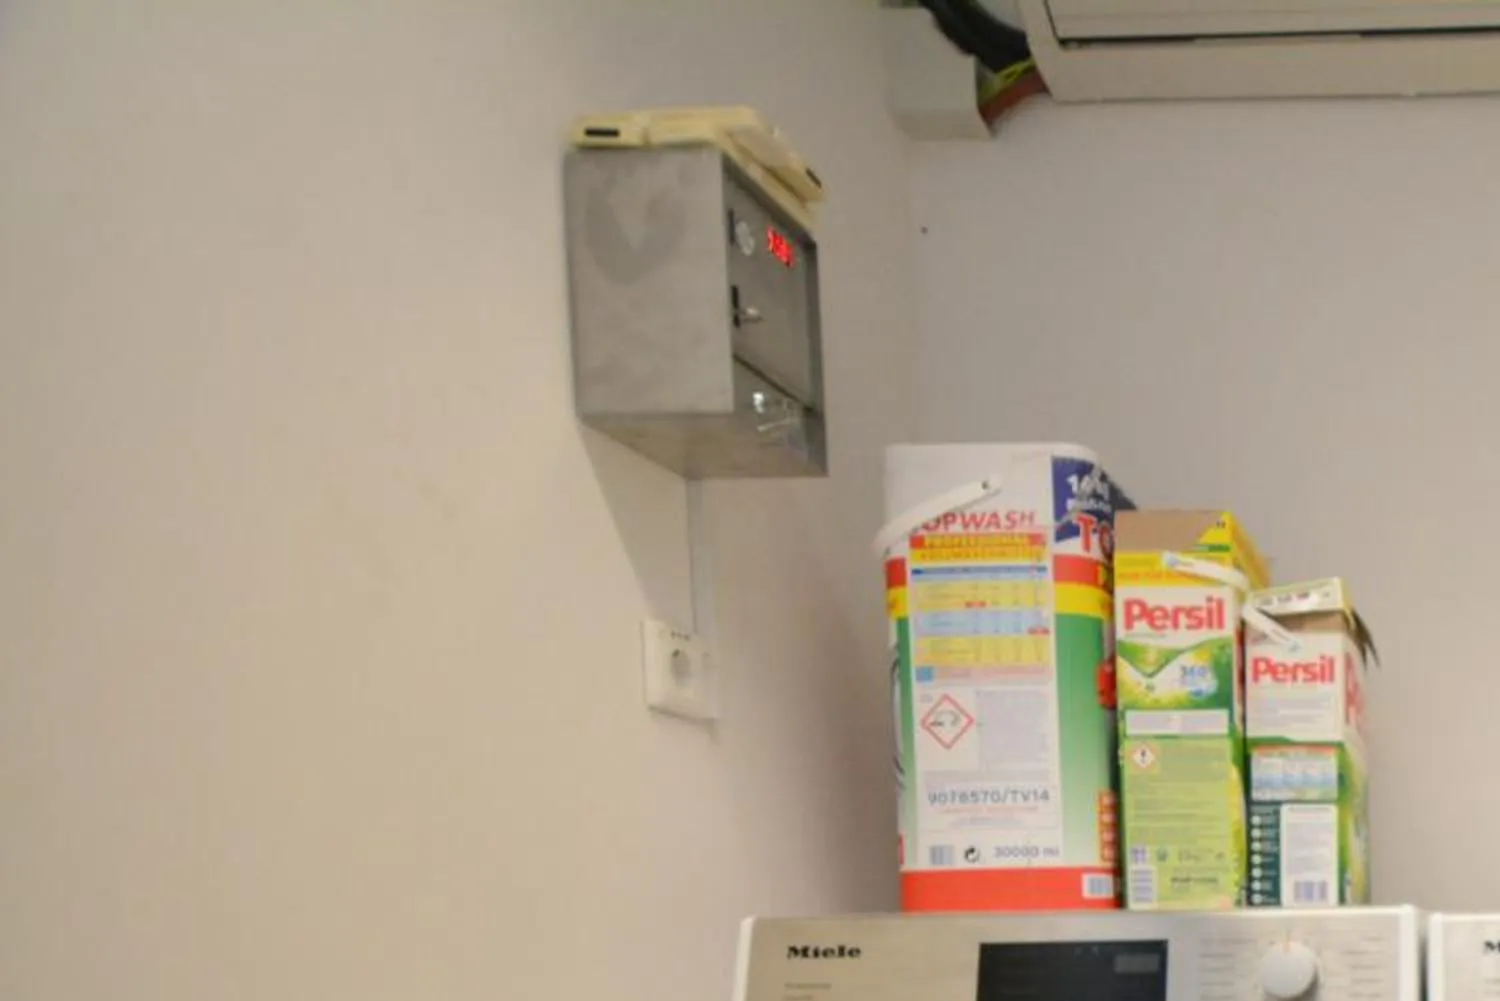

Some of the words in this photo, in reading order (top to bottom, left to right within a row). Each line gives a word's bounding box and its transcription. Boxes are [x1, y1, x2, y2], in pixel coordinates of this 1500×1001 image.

[918, 510, 1036, 532] OPWASH
[1124, 596, 1225, 631] Persil
[1252, 655, 1335, 684] Persil
[786, 944, 862, 959] Miele
